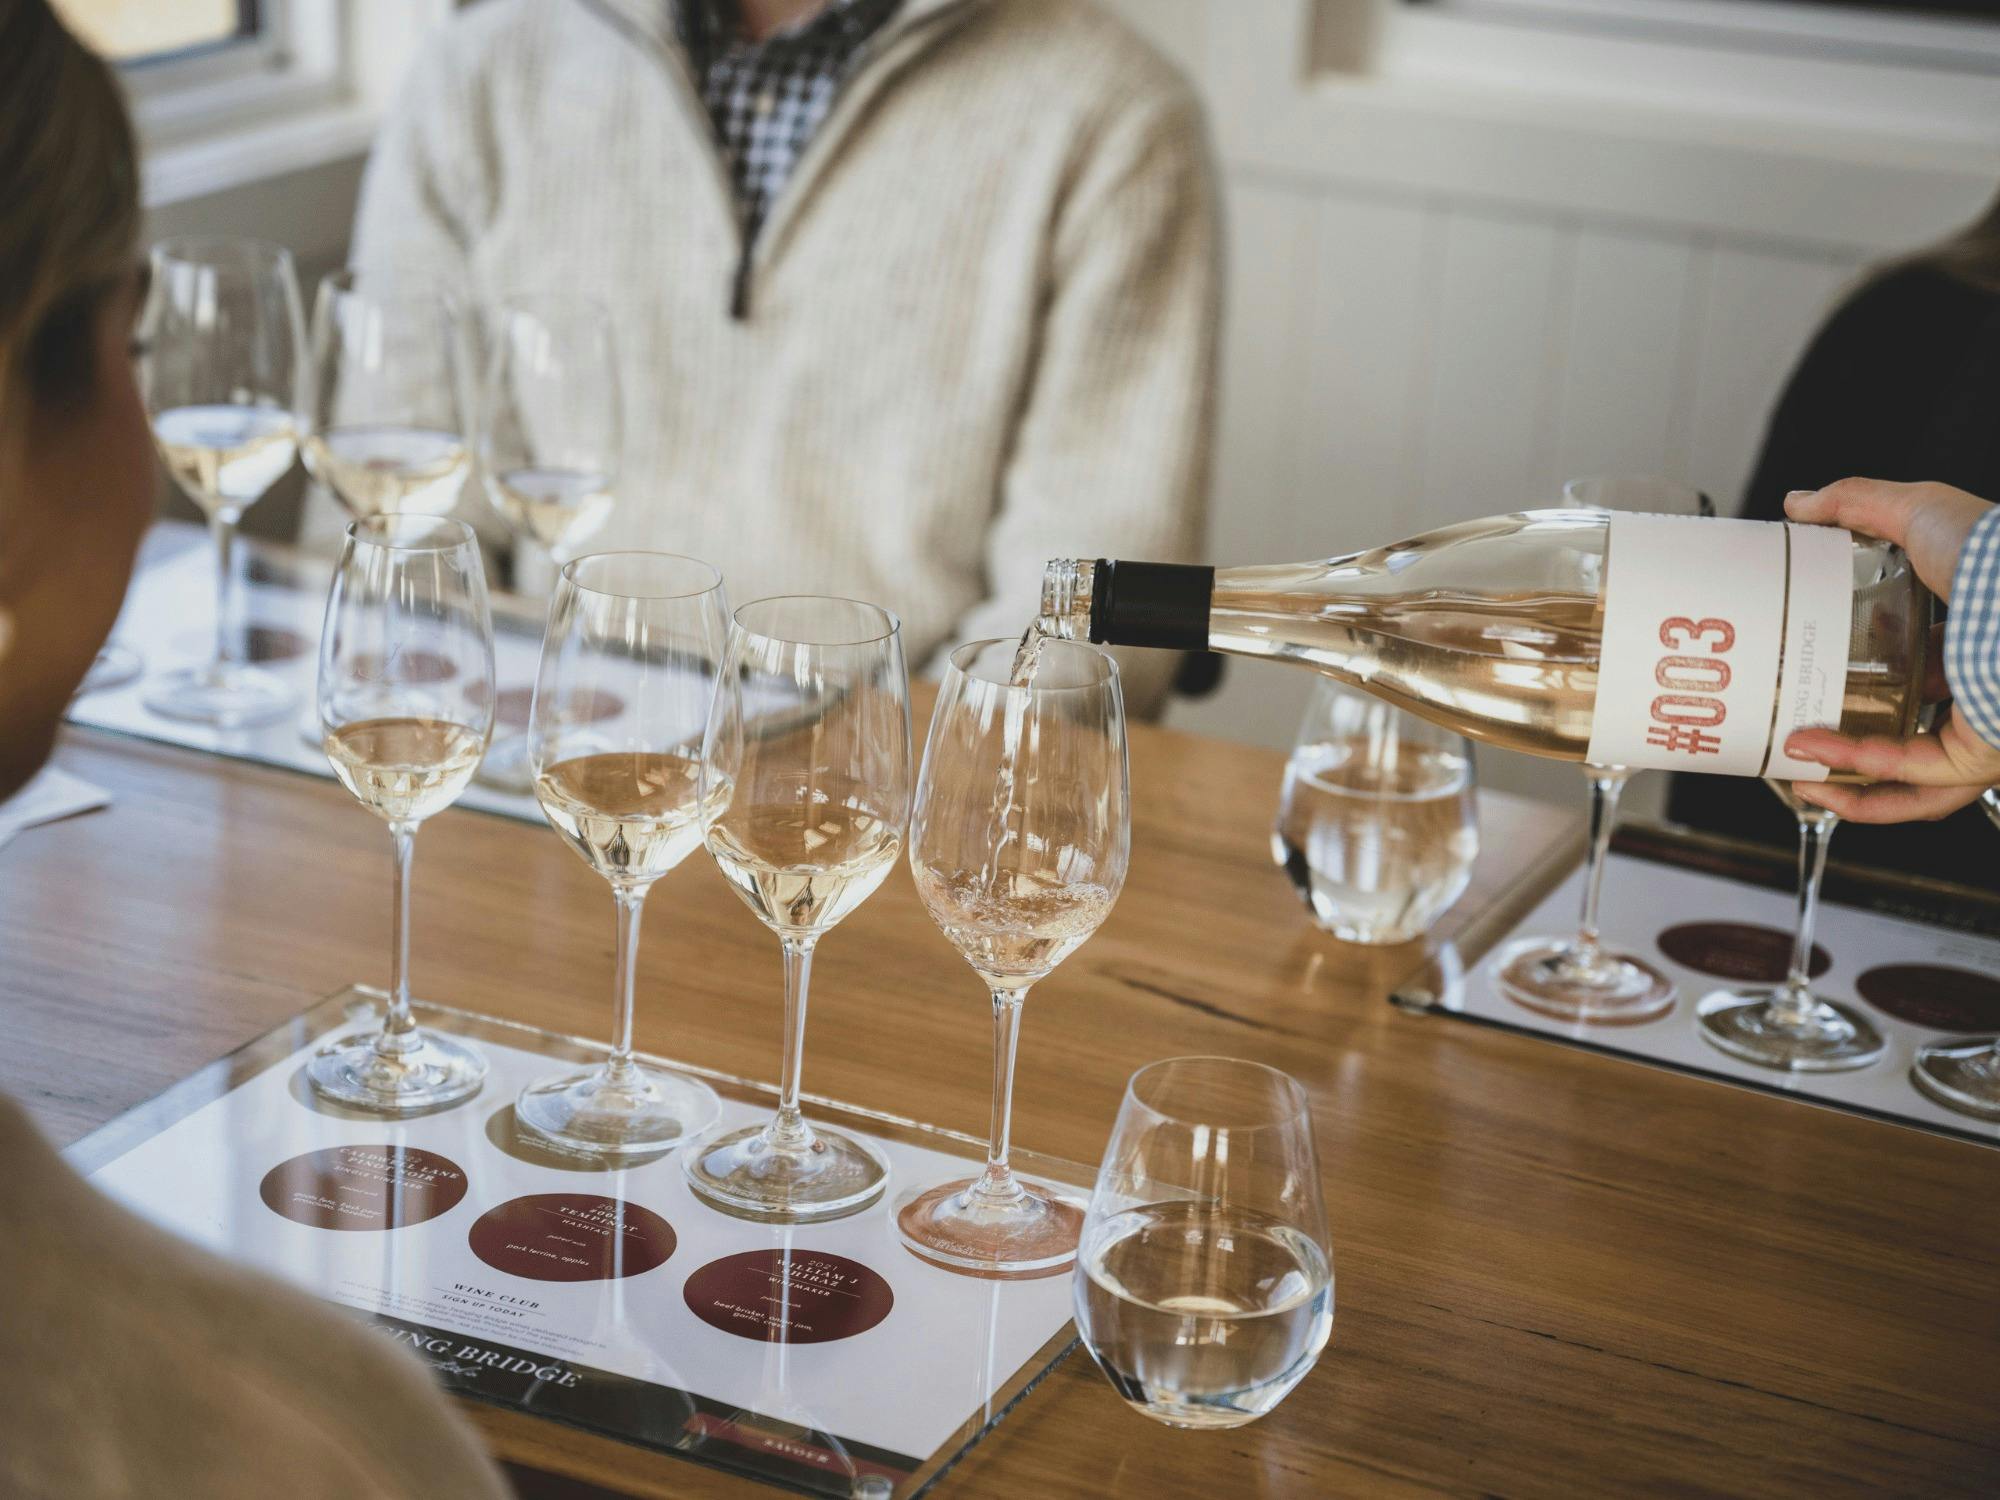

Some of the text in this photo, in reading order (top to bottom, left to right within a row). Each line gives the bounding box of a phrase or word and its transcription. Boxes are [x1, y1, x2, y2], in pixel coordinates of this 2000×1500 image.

[1797, 619, 1817, 686] BRIDGE
[1646, 616, 1736, 754] #003
[340, 1148, 417, 1170] CALDWEL
[420, 1166, 460, 1179] LANE
[372, 1174, 423, 1190] VINEARD
[561, 1219, 610, 1236] HASHTAG
[506, 1244, 590, 1267] pork terrine, apples
[807, 1260, 839, 1271] 2021
[768, 1276, 831, 1297] WINEMAKER
[781, 1270, 840, 1288] HIRAZ
[441, 1293, 469, 1304] SIGN
[471, 1301, 486, 1309] UP
[488, 1305, 526, 1318] TODAY
[453, 1283, 541, 1309] WINE CLUB
[713, 1300, 735, 1310] beef
[454, 1345, 583, 1388] BRIDGE
